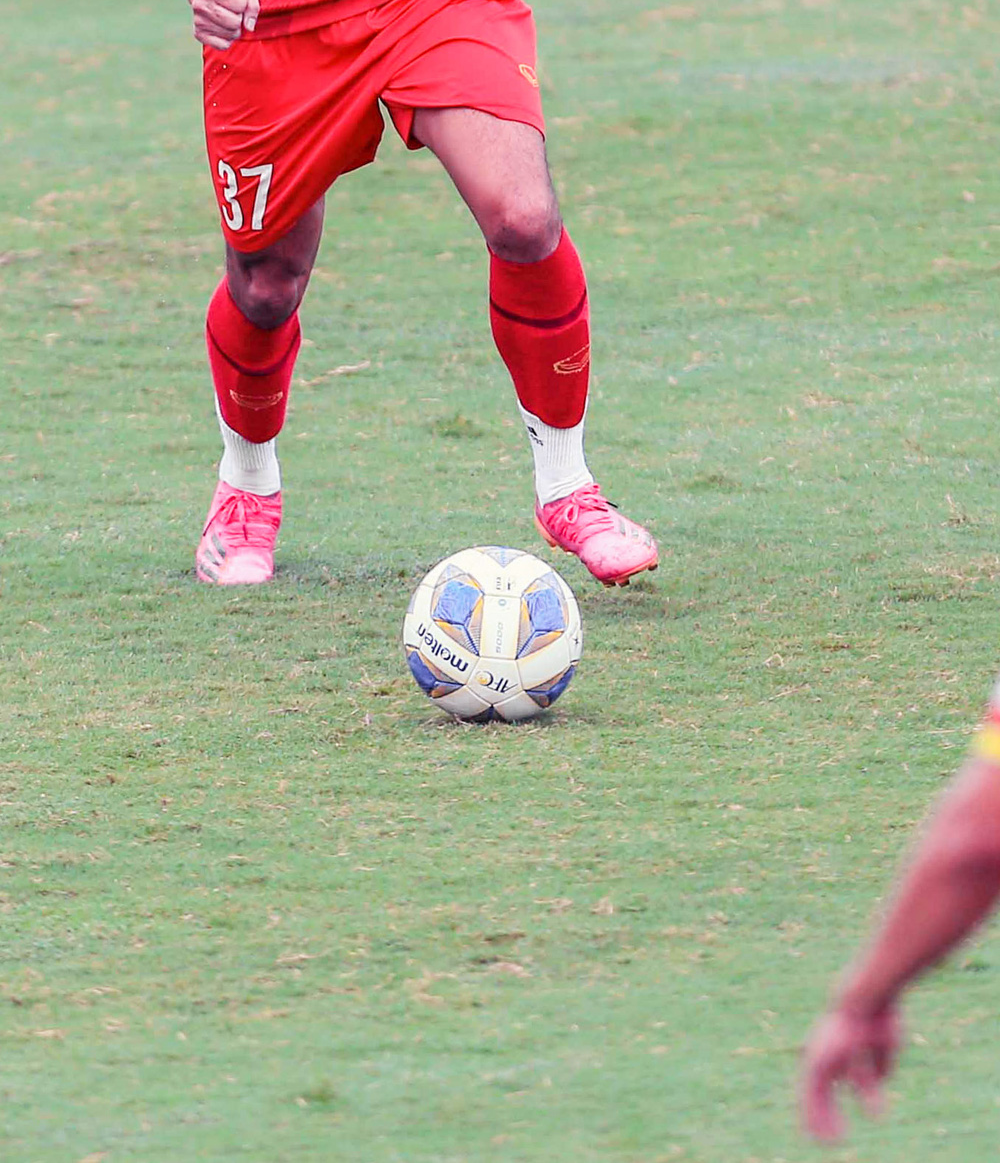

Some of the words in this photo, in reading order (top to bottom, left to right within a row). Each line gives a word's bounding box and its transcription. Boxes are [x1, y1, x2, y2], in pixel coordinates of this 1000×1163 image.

[218, 159, 273, 230] 37
[416, 622, 470, 673] molten
[476, 669, 519, 694] AFC
